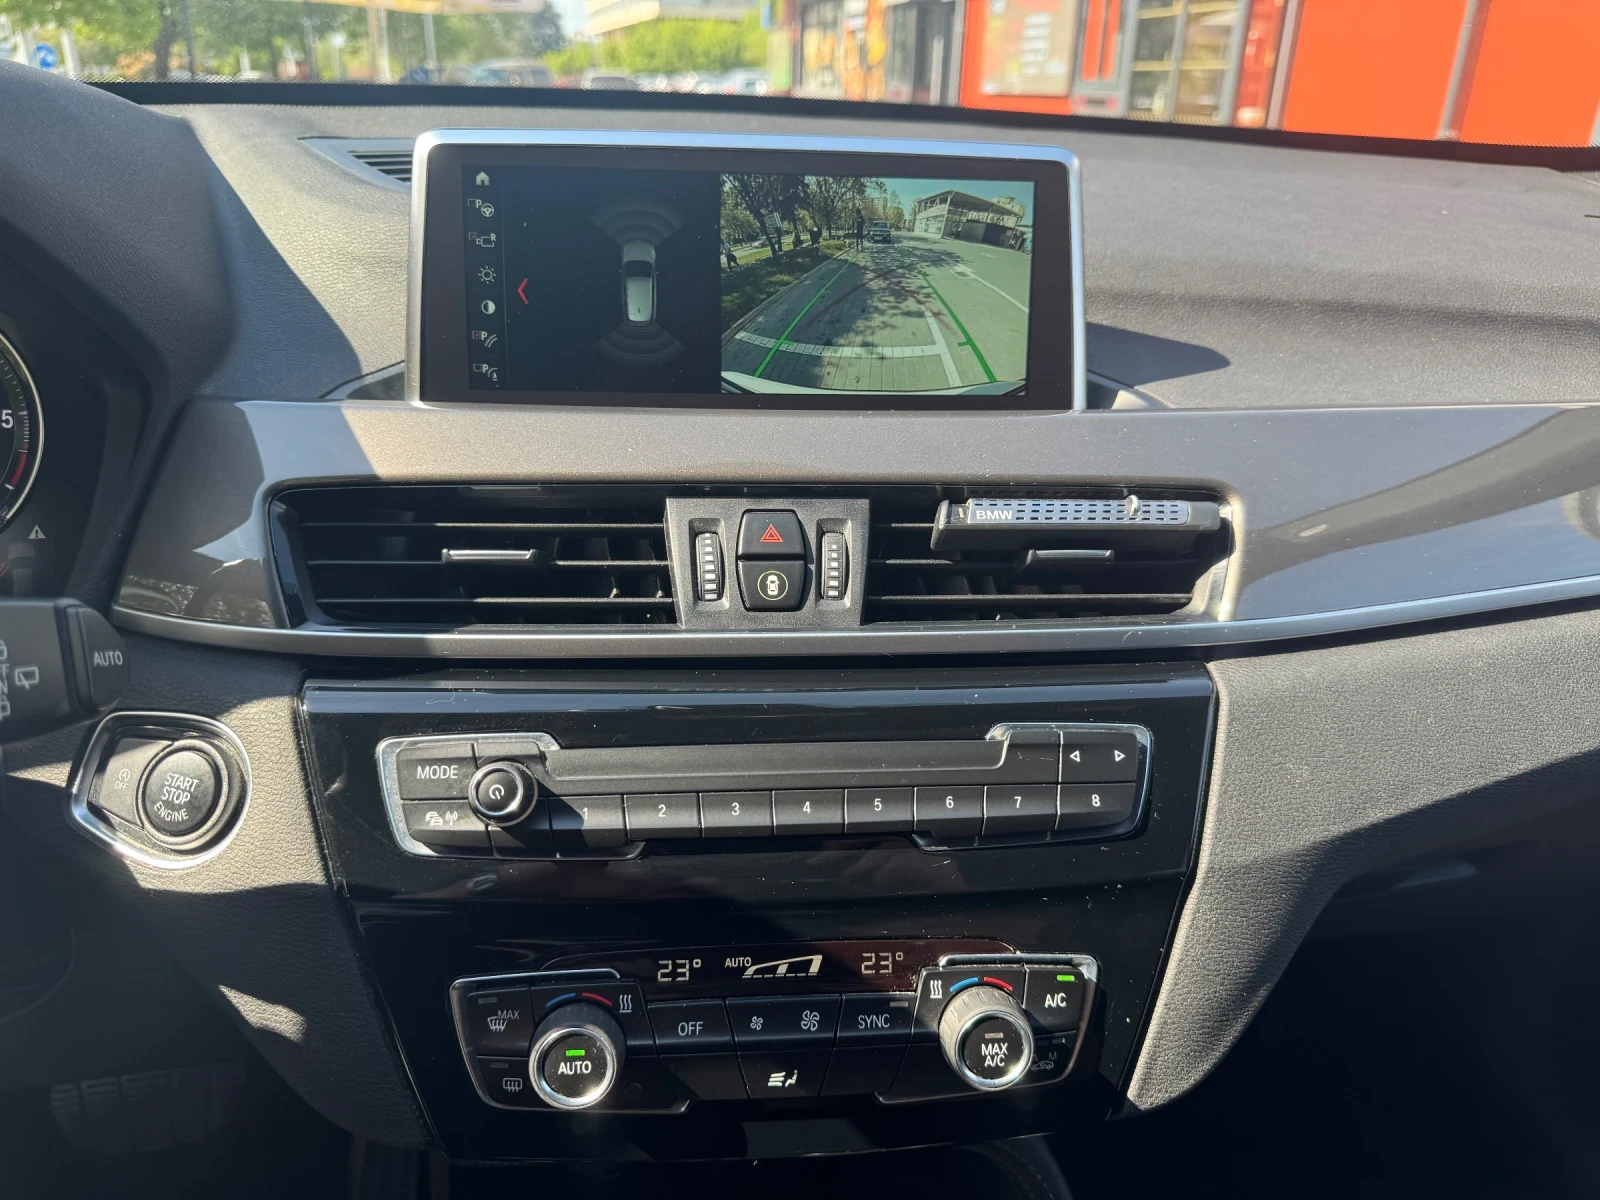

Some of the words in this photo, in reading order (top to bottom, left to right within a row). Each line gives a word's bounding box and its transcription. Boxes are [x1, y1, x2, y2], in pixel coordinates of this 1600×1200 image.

[1, 409, 14, 428] 5
[976, 510, 1013, 520] BMW
[94, 651, 123, 666] AUTO
[416, 765, 459, 780] MODE
[114, 780, 129, 791] OFF
[164, 772, 200, 793] START
[161, 786, 191, 805] STOP
[945, 796, 954, 809] 6
[1091, 794, 1100, 807] 8
[731, 803, 740, 816] 3
[803, 802, 811, 815] 4
[873, 798, 882, 812] 5
[1014, 797, 1022, 809] 7
[154, 800, 190, 822] ENGINE
[582, 807, 588, 820] 1
[658, 804, 666, 818] 2
[724, 957, 752, 968] AUTO
[657, 959, 702, 982] 23°
[1045, 992, 1067, 1008] A/C
[497, 1009, 520, 1020] MAX
[858, 1013, 890, 1029] SYNC
[678, 1021, 704, 1036] OFF
[981, 1042, 1008, 1056] MAX
[984, 1054, 1006, 1067] A/C
[557, 1060, 592, 1076] AUTO
